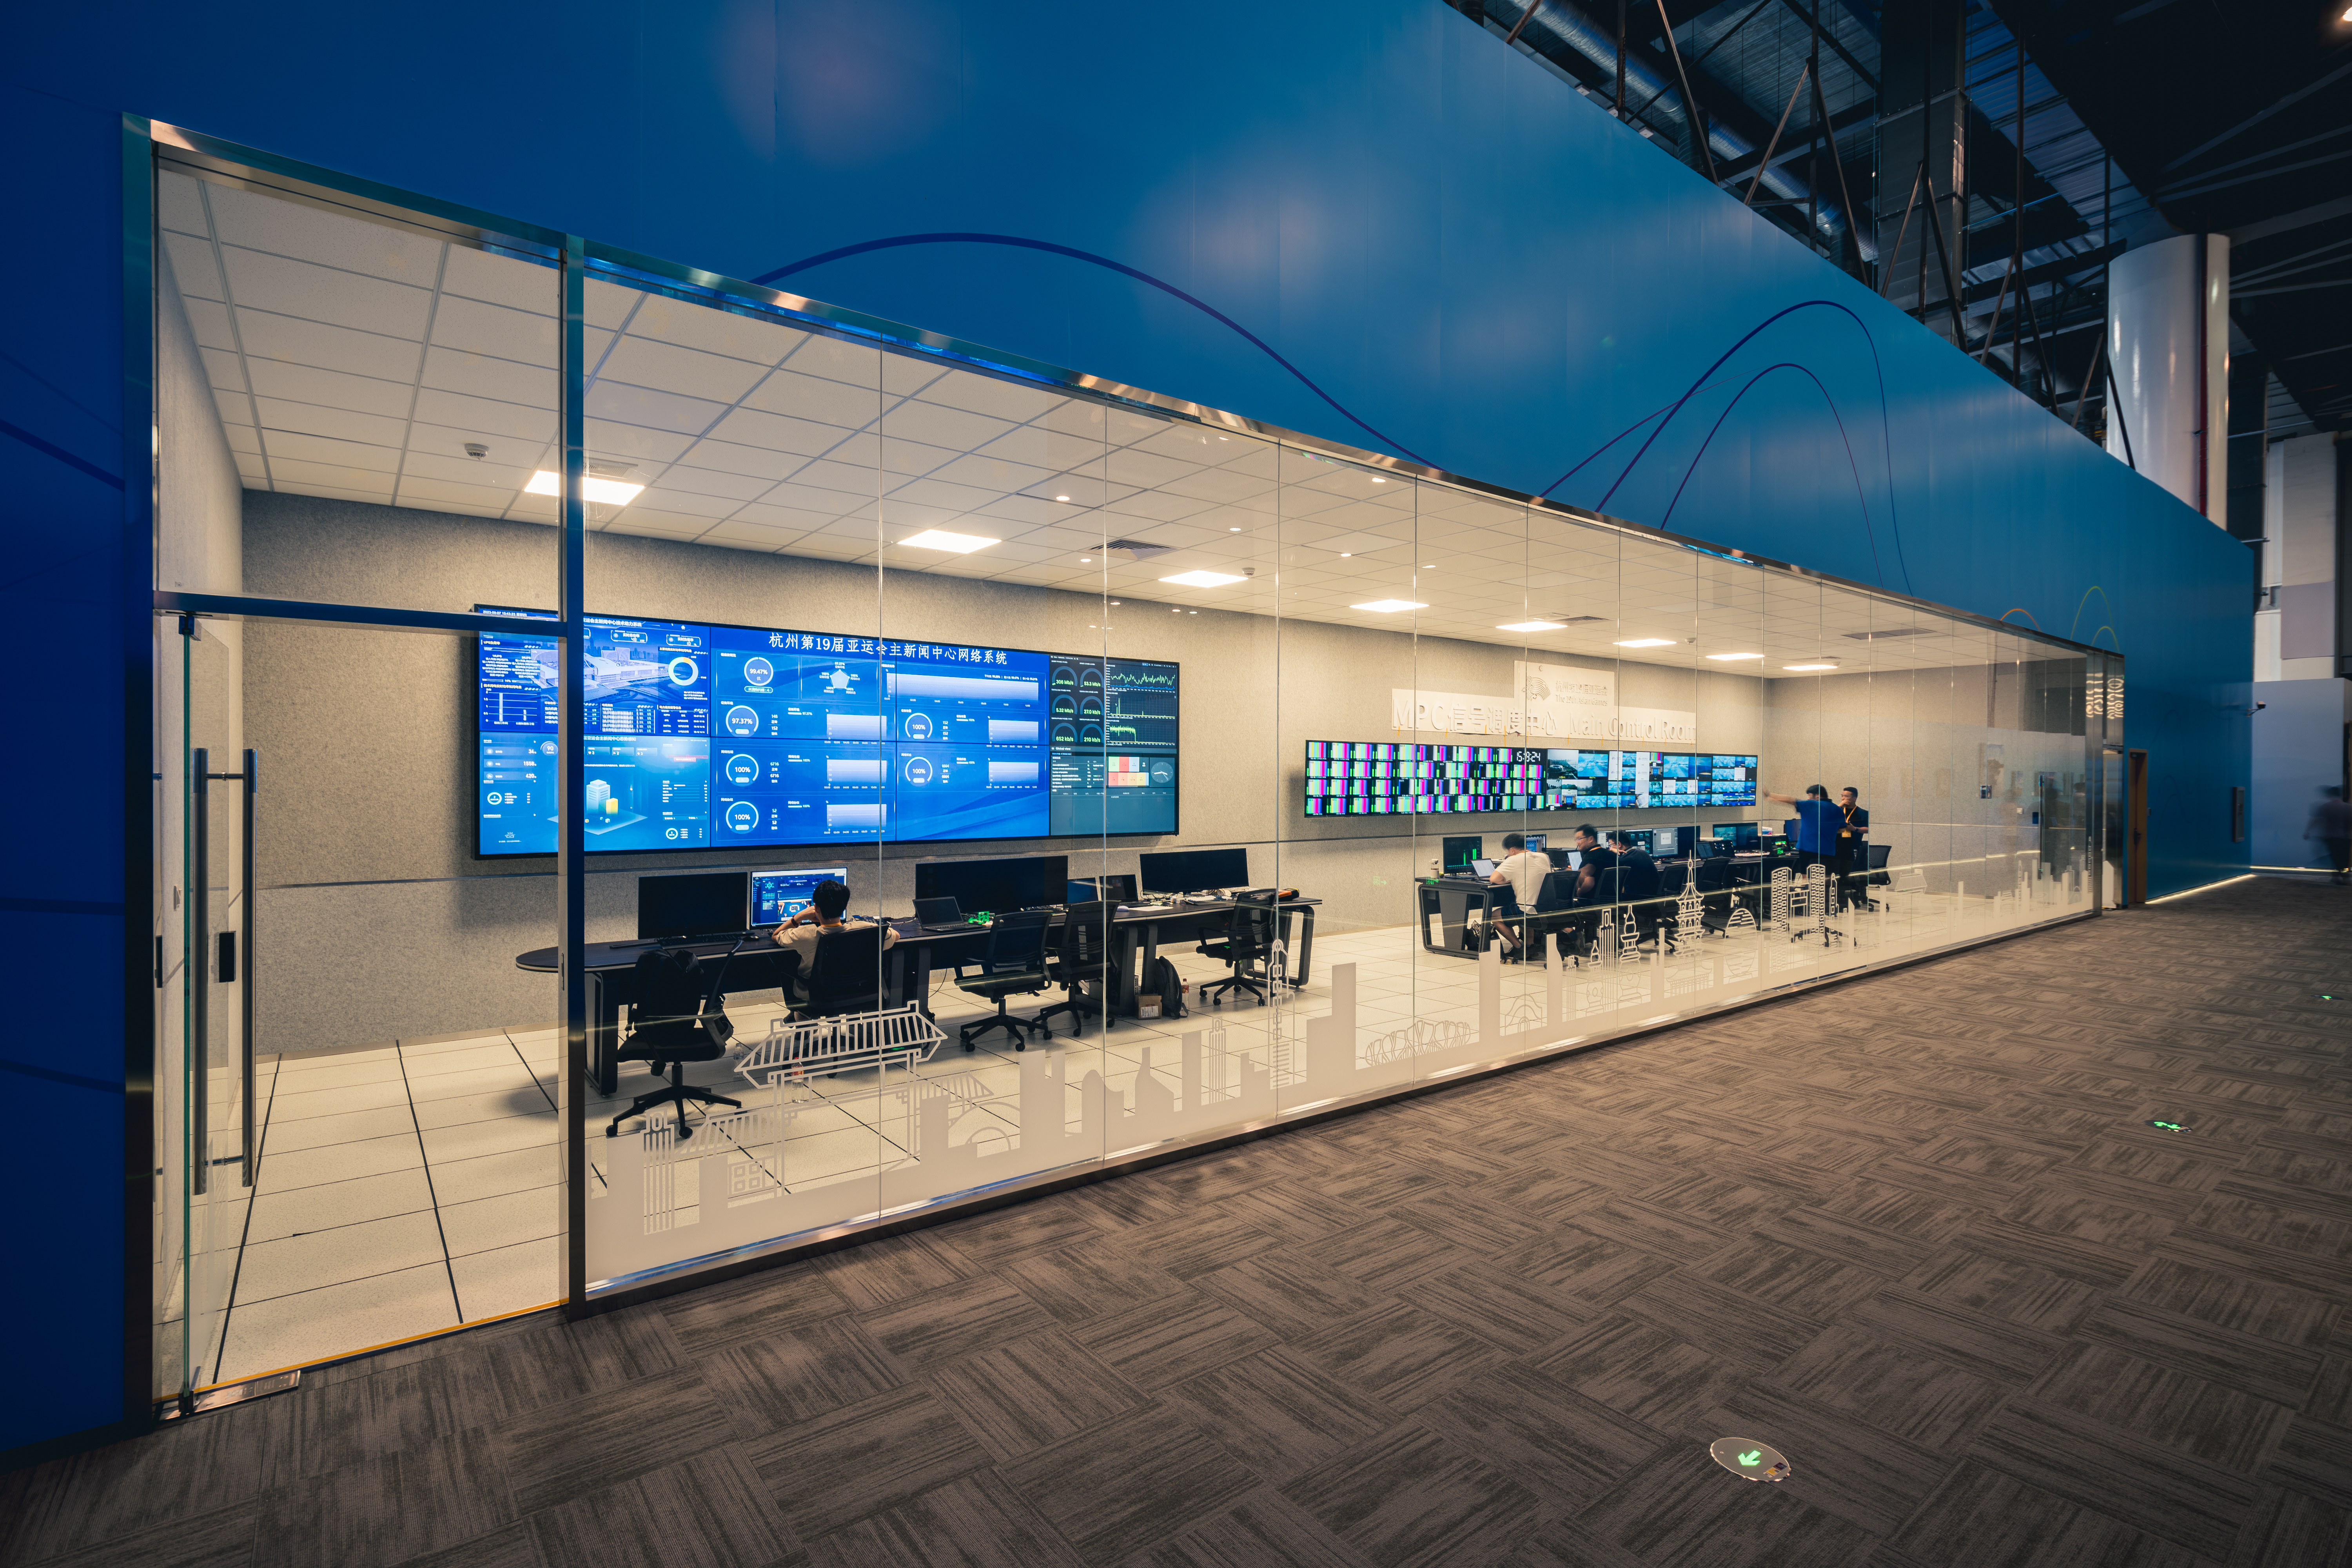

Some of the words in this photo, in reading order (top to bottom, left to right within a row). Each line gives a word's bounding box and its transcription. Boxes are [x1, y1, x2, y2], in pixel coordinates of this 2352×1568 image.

[769, 632, 1007, 665] 杭州第19届亚运会主新闻中心网络系统
[1555, 681, 1608, 696] 杭州第19届亚运会
[1556, 694, 1565, 703] The
[1578, 697, 1590, 705] Asian
[1592, 698, 1608, 706] Games
[1570, 711, 1603, 736] Main
[1608, 715, 1657, 739] Control
[1661, 719, 1696, 740] Room
